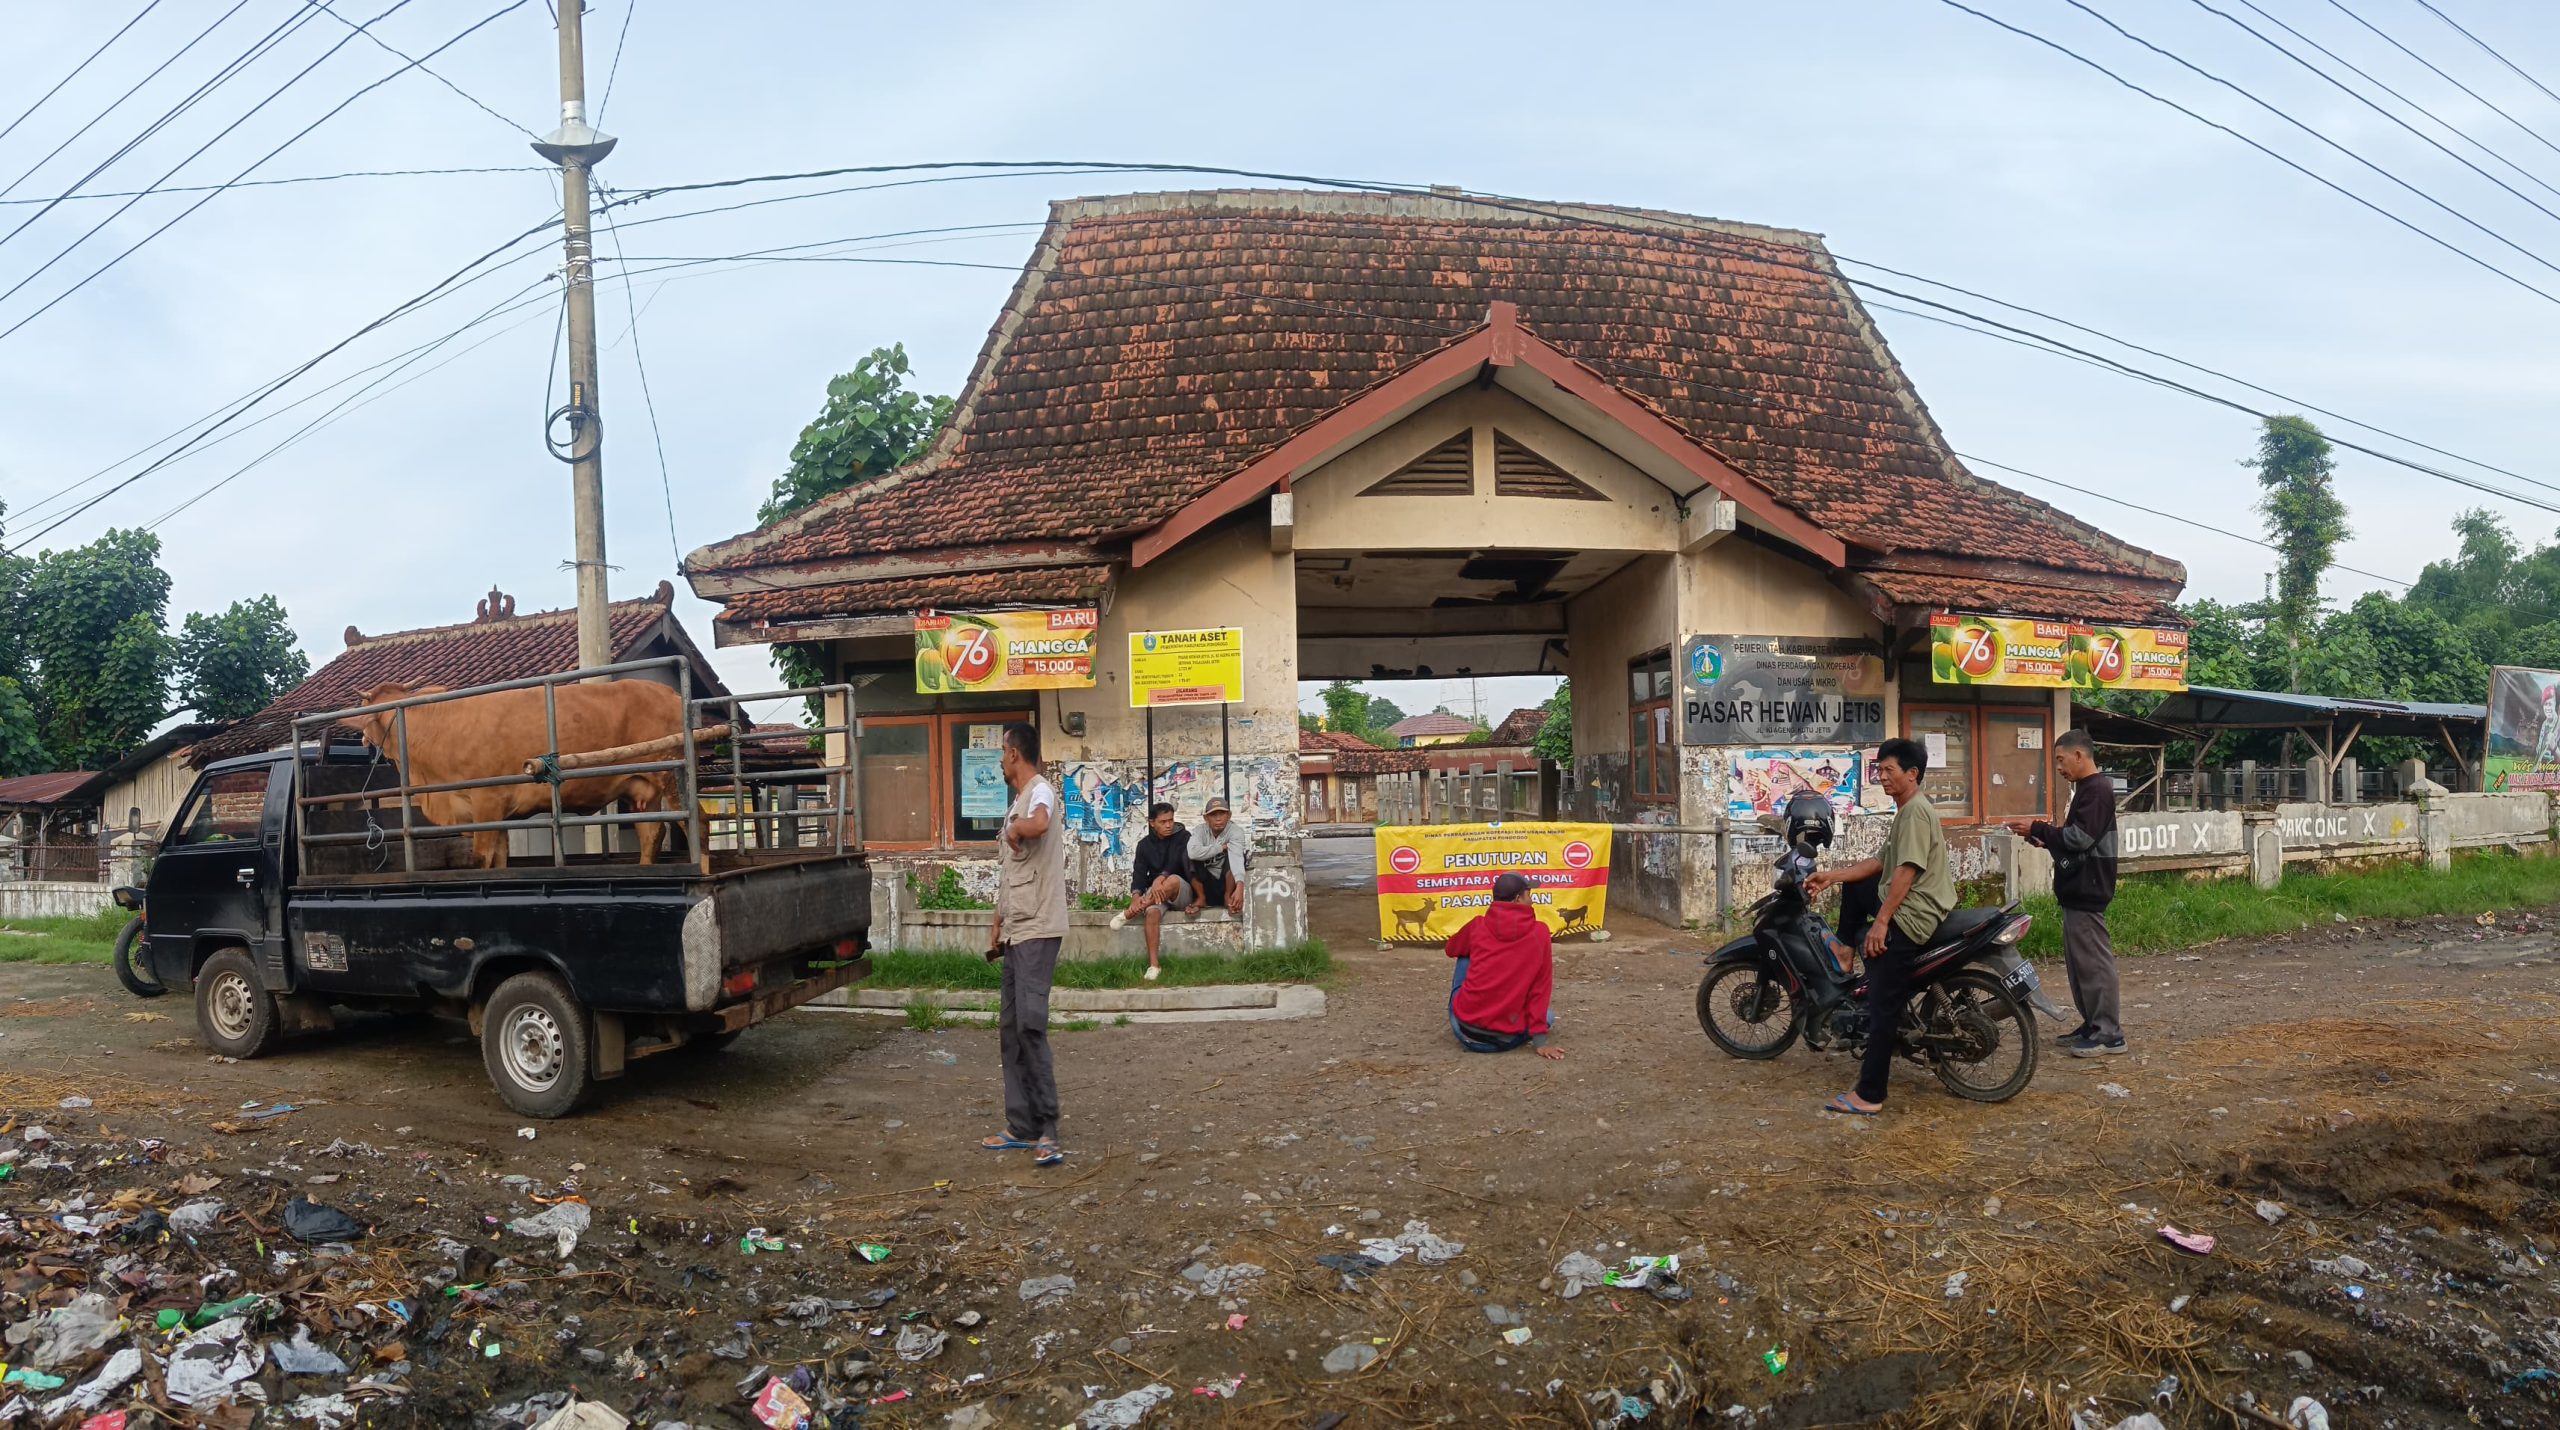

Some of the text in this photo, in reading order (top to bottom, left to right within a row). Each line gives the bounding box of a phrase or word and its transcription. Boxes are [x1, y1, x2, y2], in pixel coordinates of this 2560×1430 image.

[1052, 612, 1096, 626] BARU
[2037, 624, 2068, 636] BARU
[1160, 632, 1228, 644] TANAH ASET
[2157, 632, 2186, 644] BARU
[1009, 639, 1089, 655] MANGGA
[1734, 643, 1784, 654] PEMERINTAH
[2006, 644, 2062, 658] MANGGA
[2131, 651, 2180, 664] MANGGA
[1034, 660, 1075, 672] 15.000
[1757, 661, 1776, 669] DINAS
[2025, 661, 2053, 673] 15.000
[2147, 667, 2172, 678] 15.000
[1778, 677, 1836, 687] DAN USAHA MIKRO
[1688, 701, 1881, 724] PASAR HEWAN JETIS
[2363, 812, 2376, 836] X
[2192, 822, 2210, 849] X
[1444, 851, 1547, 868] PENUTUPAN
[1417, 875, 1490, 888] SEMENTARA
[1441, 895, 1493, 908] PASAR
[2005, 975, 2020, 990] AE
